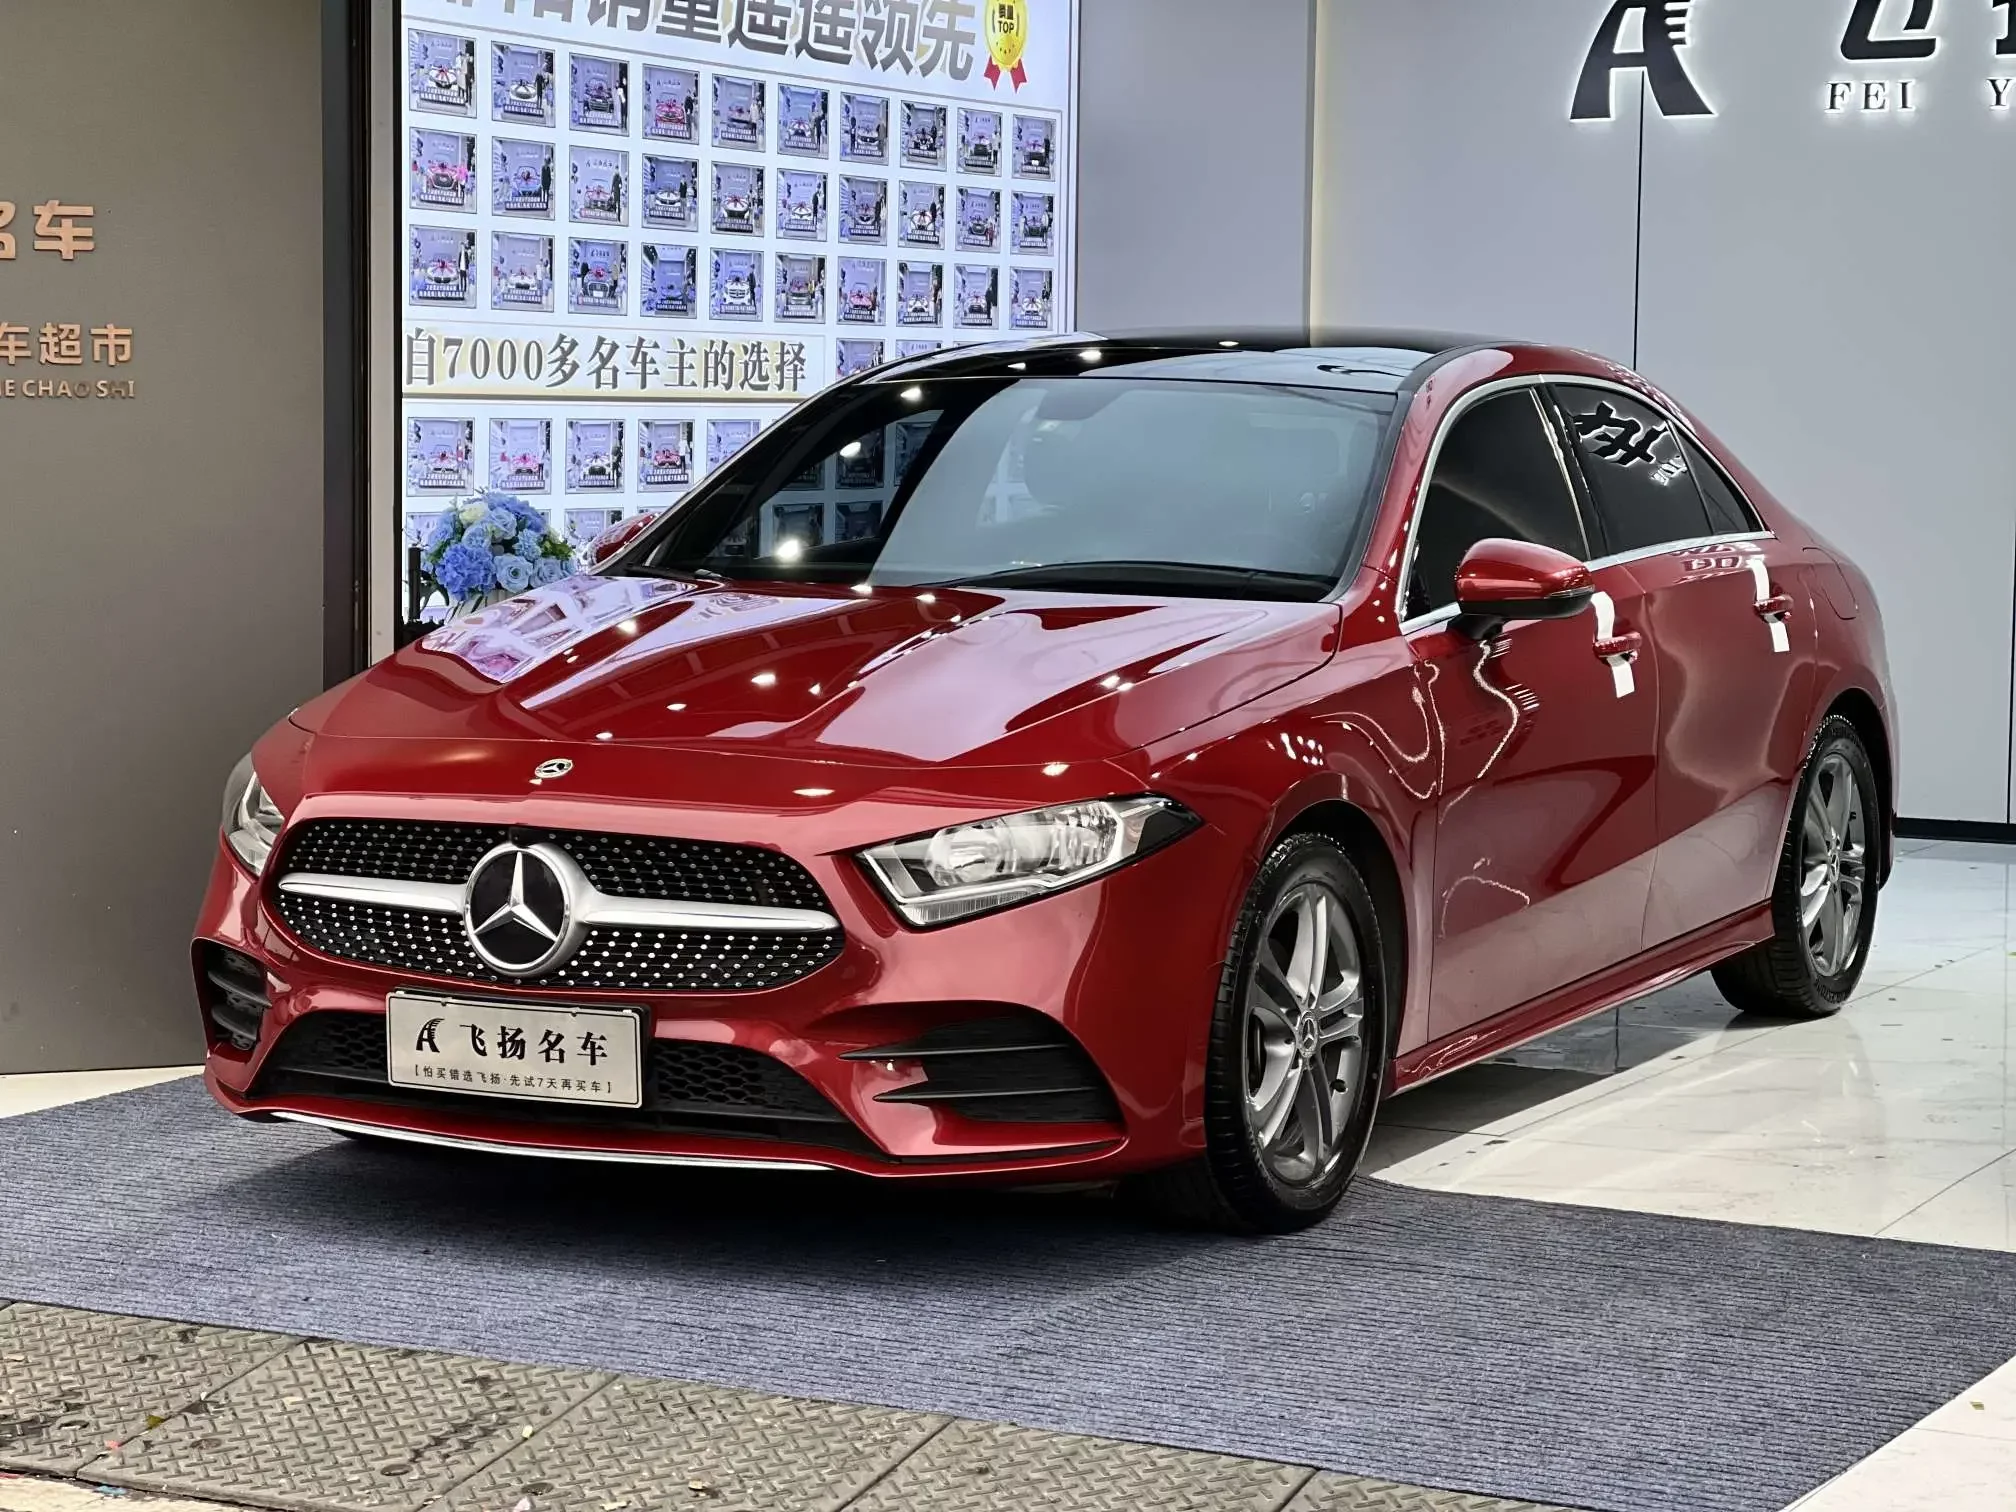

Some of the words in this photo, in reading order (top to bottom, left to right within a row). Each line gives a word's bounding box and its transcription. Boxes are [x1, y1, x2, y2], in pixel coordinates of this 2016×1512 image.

[998, 20, 1014, 34] TOP
[1825, 81, 1914, 110] FEI
[0, 199, 95, 260] 车
[405, 327, 807, 392] 自7000多名车主的选择
[22, 379, 91, 398] CHAO
[96, 380, 136, 398] SHI
[459, 1023, 608, 1066] 飞扬名车
